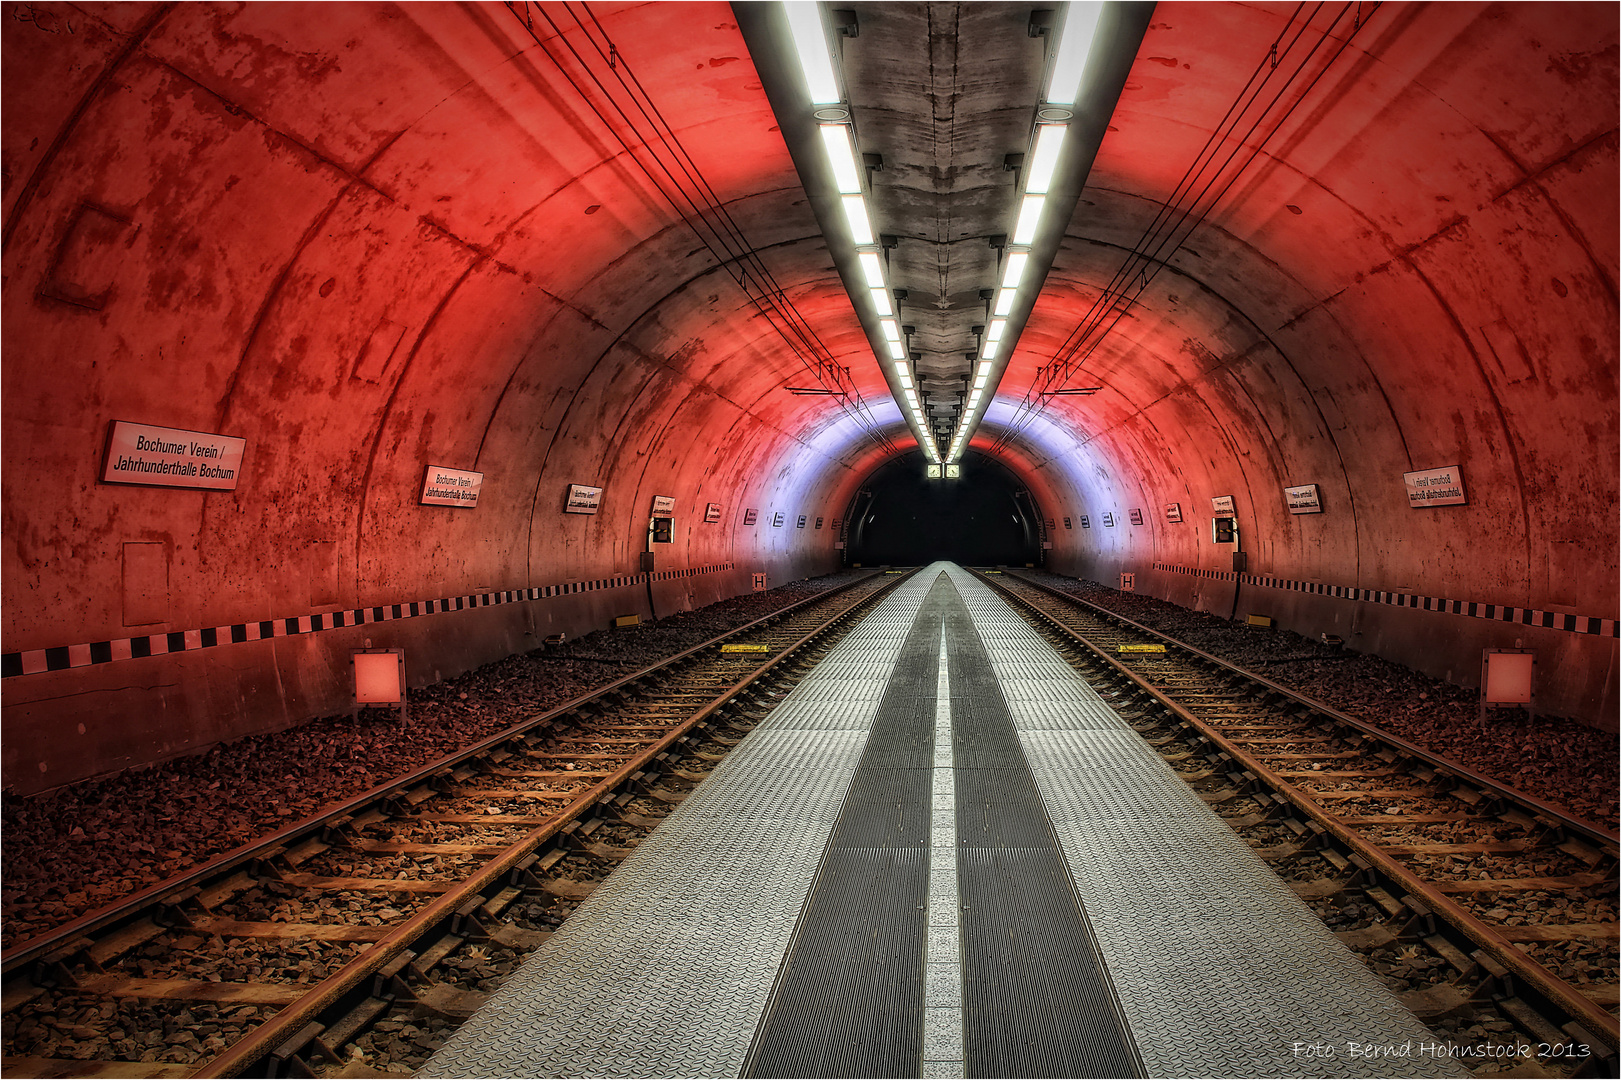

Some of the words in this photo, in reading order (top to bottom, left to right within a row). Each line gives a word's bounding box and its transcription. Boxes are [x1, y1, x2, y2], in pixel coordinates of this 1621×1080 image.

[136, 435, 187, 455] Bochumer
[190, 442, 218, 459] Verein
[219, 445, 226, 460] /
[114, 455, 197, 477] Jahrhunderthalle
[199, 463, 235, 480] Bochum
[755, 576, 764, 588] H
[1123, 576, 1132, 588] H
